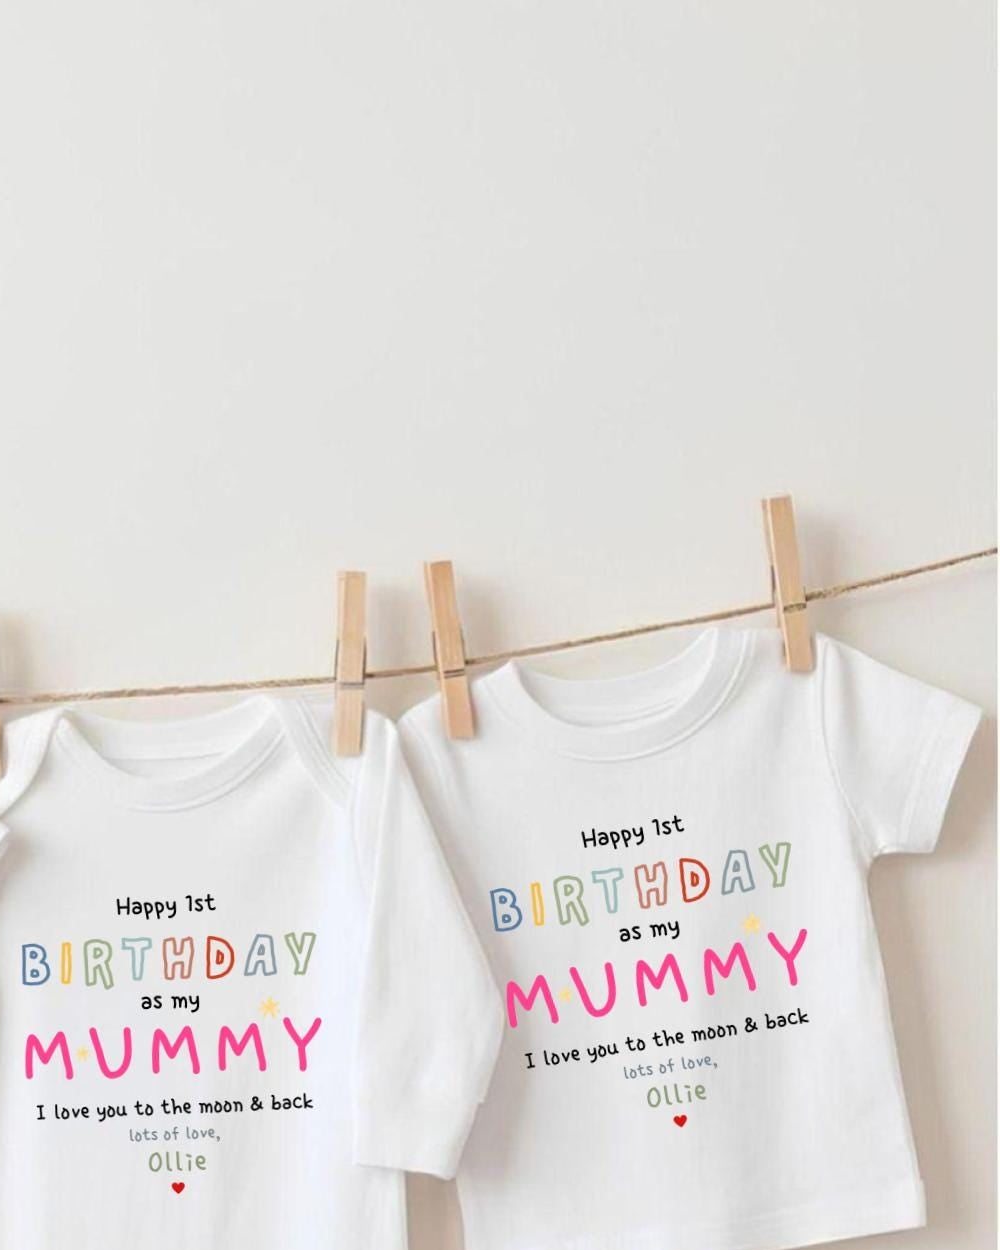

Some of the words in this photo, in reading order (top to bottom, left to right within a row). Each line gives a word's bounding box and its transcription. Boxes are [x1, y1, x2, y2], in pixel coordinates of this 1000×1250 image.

[580, 825, 645, 851] Happy
[650, 813, 686, 837] 1st
[488, 840, 793, 933] BIRTHDAY
[115, 896, 178, 921] Happy
[184, 893, 217, 913] 1st
[618, 925, 643, 943] as
[648, 919, 681, 941] my
[21, 931, 317, 991] BIRTHDAY
[505, 927, 809, 1029] MUMMY
[140, 994, 163, 1011] as
[169, 994, 201, 1014] my
[24, 1016, 323, 1081] MUMMY
[525, 1051, 537, 1070] I
[541, 1047, 582, 1068] love
[585, 1042, 620, 1065] you
[624, 1035, 647, 1053] to
[651, 1029, 686, 1048] the
[690, 1023, 739, 1043] moon
[743, 1016, 759, 1034] &
[763, 1007, 811, 1030] back
[623, 1065, 654, 1081] lots
[658, 1057, 676, 1075] of
[680, 1055, 719, 1072] love,
[35, 1104, 47, 1121] I
[54, 1103, 91, 1121] love
[96, 1104, 129, 1123] you
[133, 1099, 155, 1117] to
[159, 1097, 193, 1116] the
[197, 1099, 244, 1116] moon
[249, 1095, 265, 1112] &
[270, 1091, 315, 1111] back
[646, 1082, 708, 1109] Ollie
[129, 1127, 159, 1143] lots
[162, 1125, 180, 1142] of
[185, 1125, 221, 1143] love,
[148, 1150, 207, 1173] Ollie
